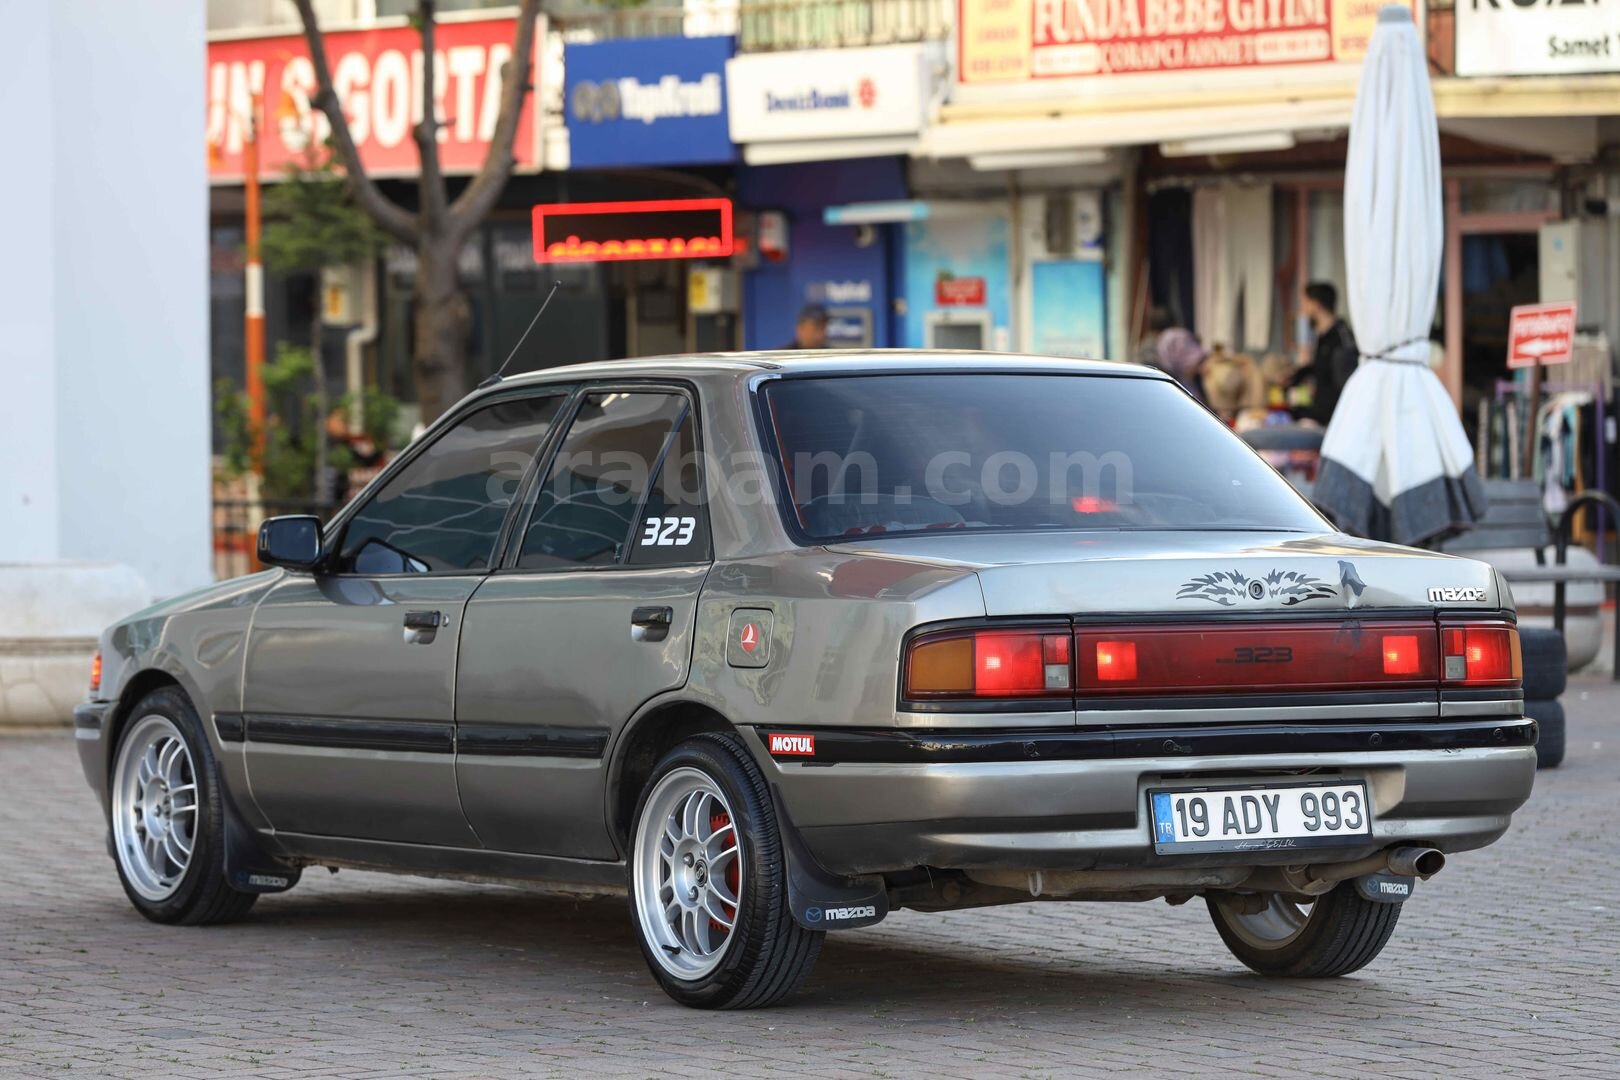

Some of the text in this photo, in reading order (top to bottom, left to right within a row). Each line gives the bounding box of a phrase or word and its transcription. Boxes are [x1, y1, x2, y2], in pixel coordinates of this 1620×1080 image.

[1549, 34, 1610, 57] Samet
[641, 516, 696, 546] 323
[1427, 587, 1488, 602] mazda
[1233, 646, 1294, 664] 323
[772, 736, 813, 753] MOTUL
[1175, 791, 1363, 837] 19 ADY 993
[1159, 822, 1174, 836] TR
[1380, 882, 1408, 895] mazda
[825, 906, 876, 920] mazda
